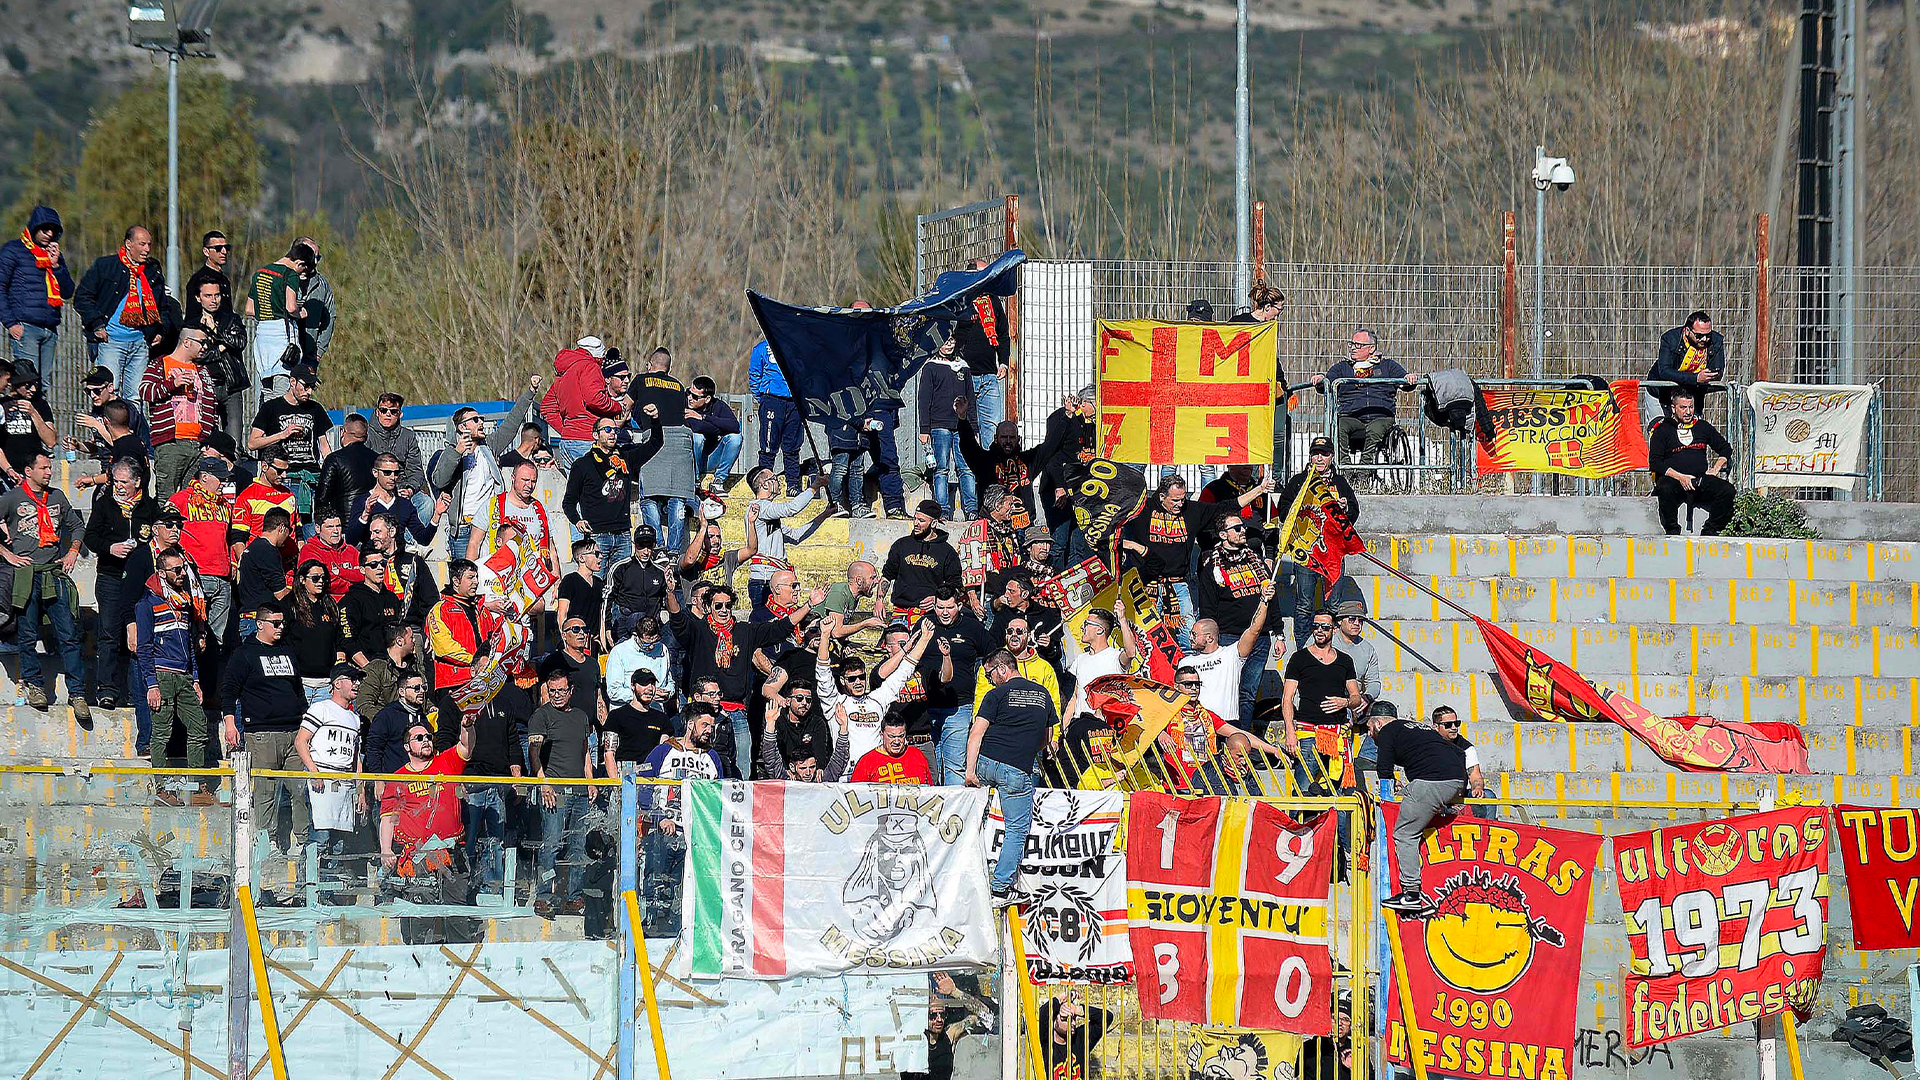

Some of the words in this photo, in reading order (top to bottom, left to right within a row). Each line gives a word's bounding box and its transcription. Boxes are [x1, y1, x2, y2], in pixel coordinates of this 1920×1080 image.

[1199, 328, 1252, 377] M
[1128, 577, 1179, 669] ULTRA
[819, 784, 963, 844] ULTRAS
[819, 923, 966, 969] MESSINA
[1632, 866, 1824, 979] 1973
[1431, 991, 1513, 1031] 1990
